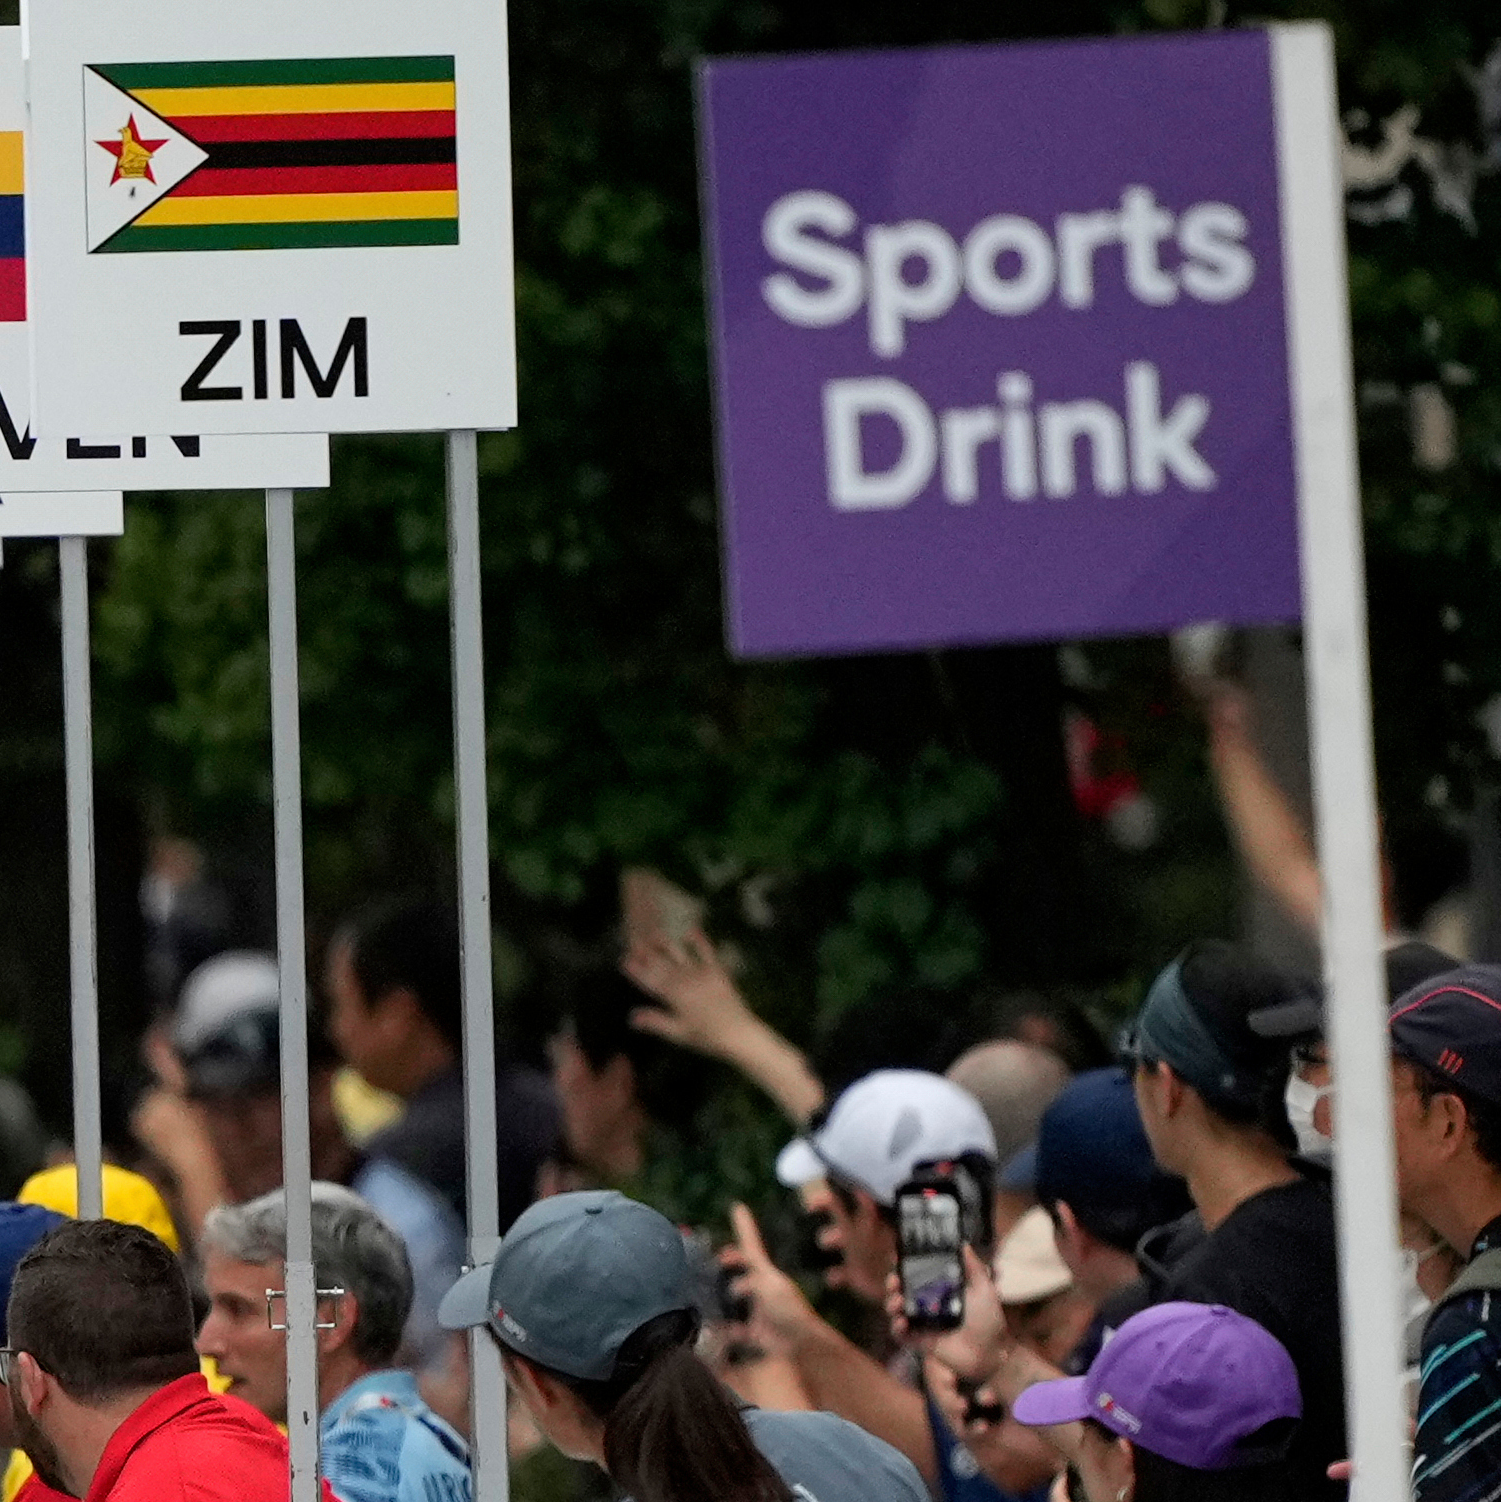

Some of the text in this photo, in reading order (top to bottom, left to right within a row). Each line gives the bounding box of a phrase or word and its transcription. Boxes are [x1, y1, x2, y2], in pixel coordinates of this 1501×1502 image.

[762, 184, 1257, 357] Sports
[179, 317, 369, 401] ZIM
[821, 361, 1218, 511] Drink
